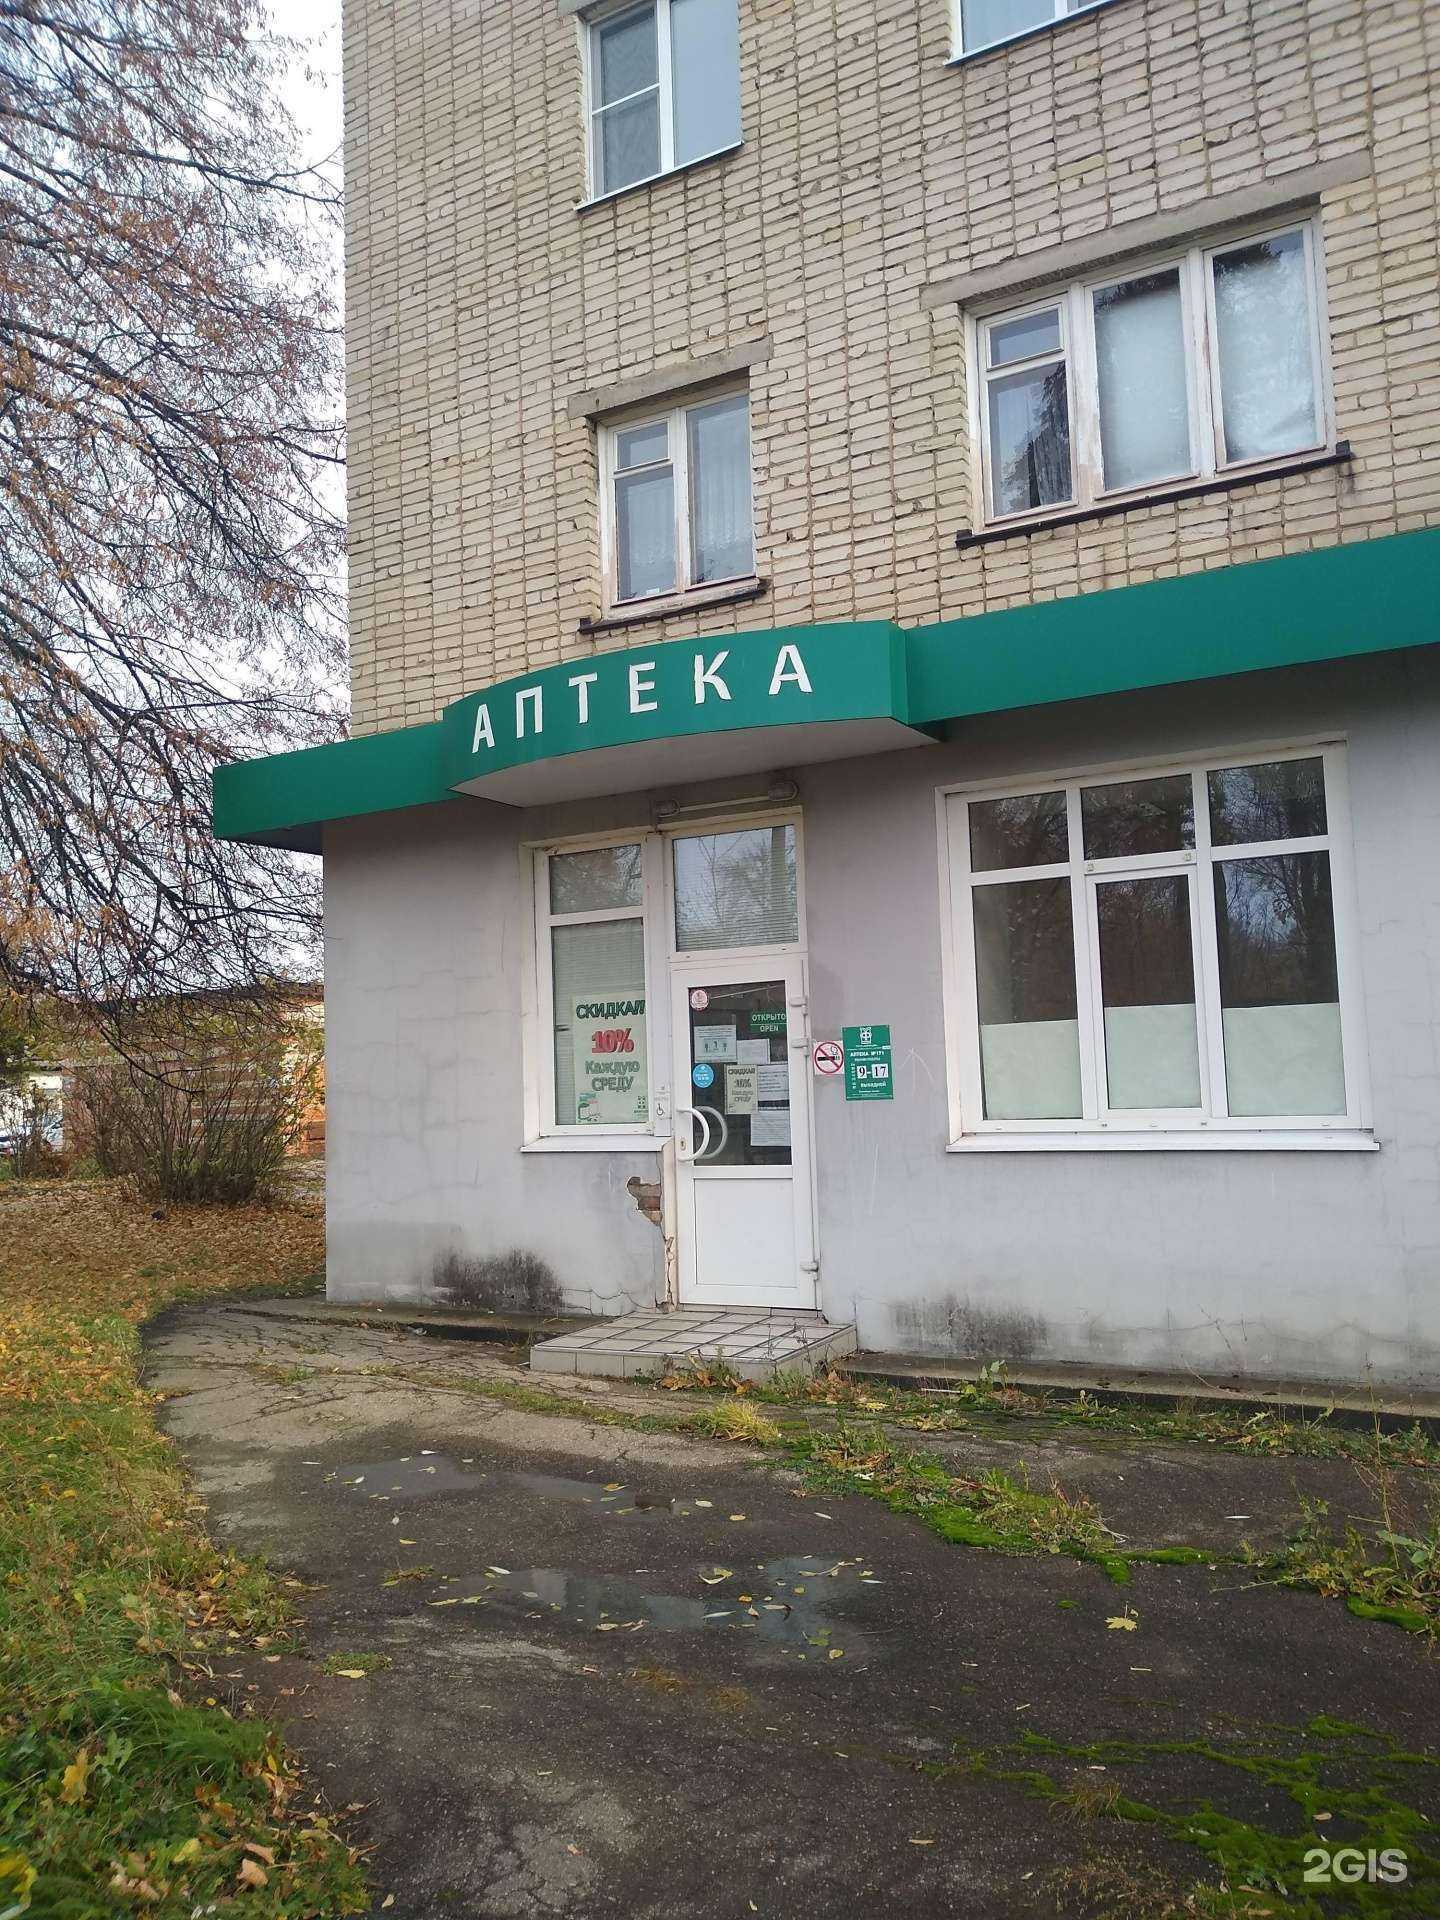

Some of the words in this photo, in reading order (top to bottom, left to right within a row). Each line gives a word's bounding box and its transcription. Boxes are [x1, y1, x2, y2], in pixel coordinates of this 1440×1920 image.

[471, 644, 813, 754] АПТЕКА
[752, 1013, 787, 1022] ОТКРЫТО
[759, 1025, 779, 1033] OPEN
[591, 1028, 635, 1054] 10%
[591, 1076, 634, 1093] СРЕДУ
